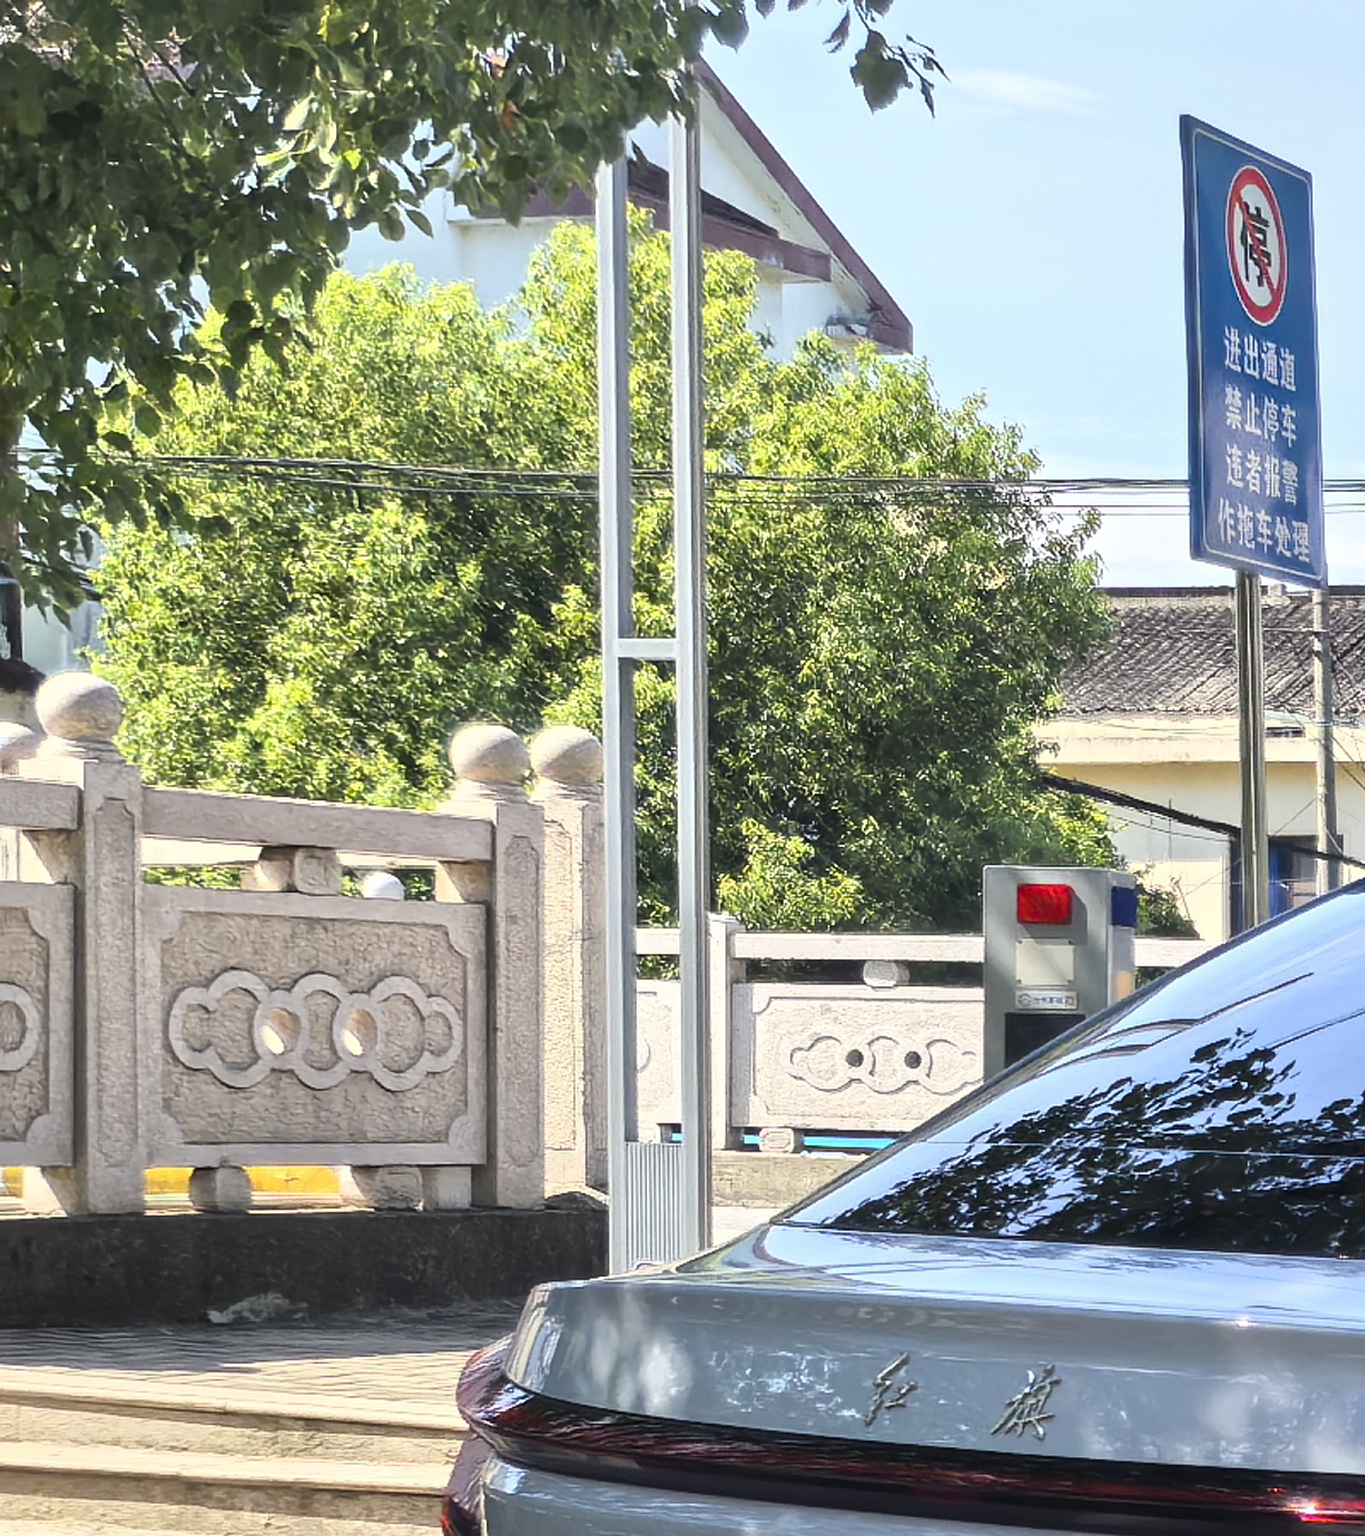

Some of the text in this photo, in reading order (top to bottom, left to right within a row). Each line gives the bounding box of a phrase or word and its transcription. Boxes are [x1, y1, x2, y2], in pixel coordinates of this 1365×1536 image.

[1238, 201, 1274, 287] 停
[1223, 326, 1296, 391] 进出通道
[1225, 384, 1297, 448] 禁止停车
[1226, 443, 1298, 504] 违者报警
[1218, 498, 1310, 563] 作拖车处理
[864, 1352, 1061, 1441] 红旗
